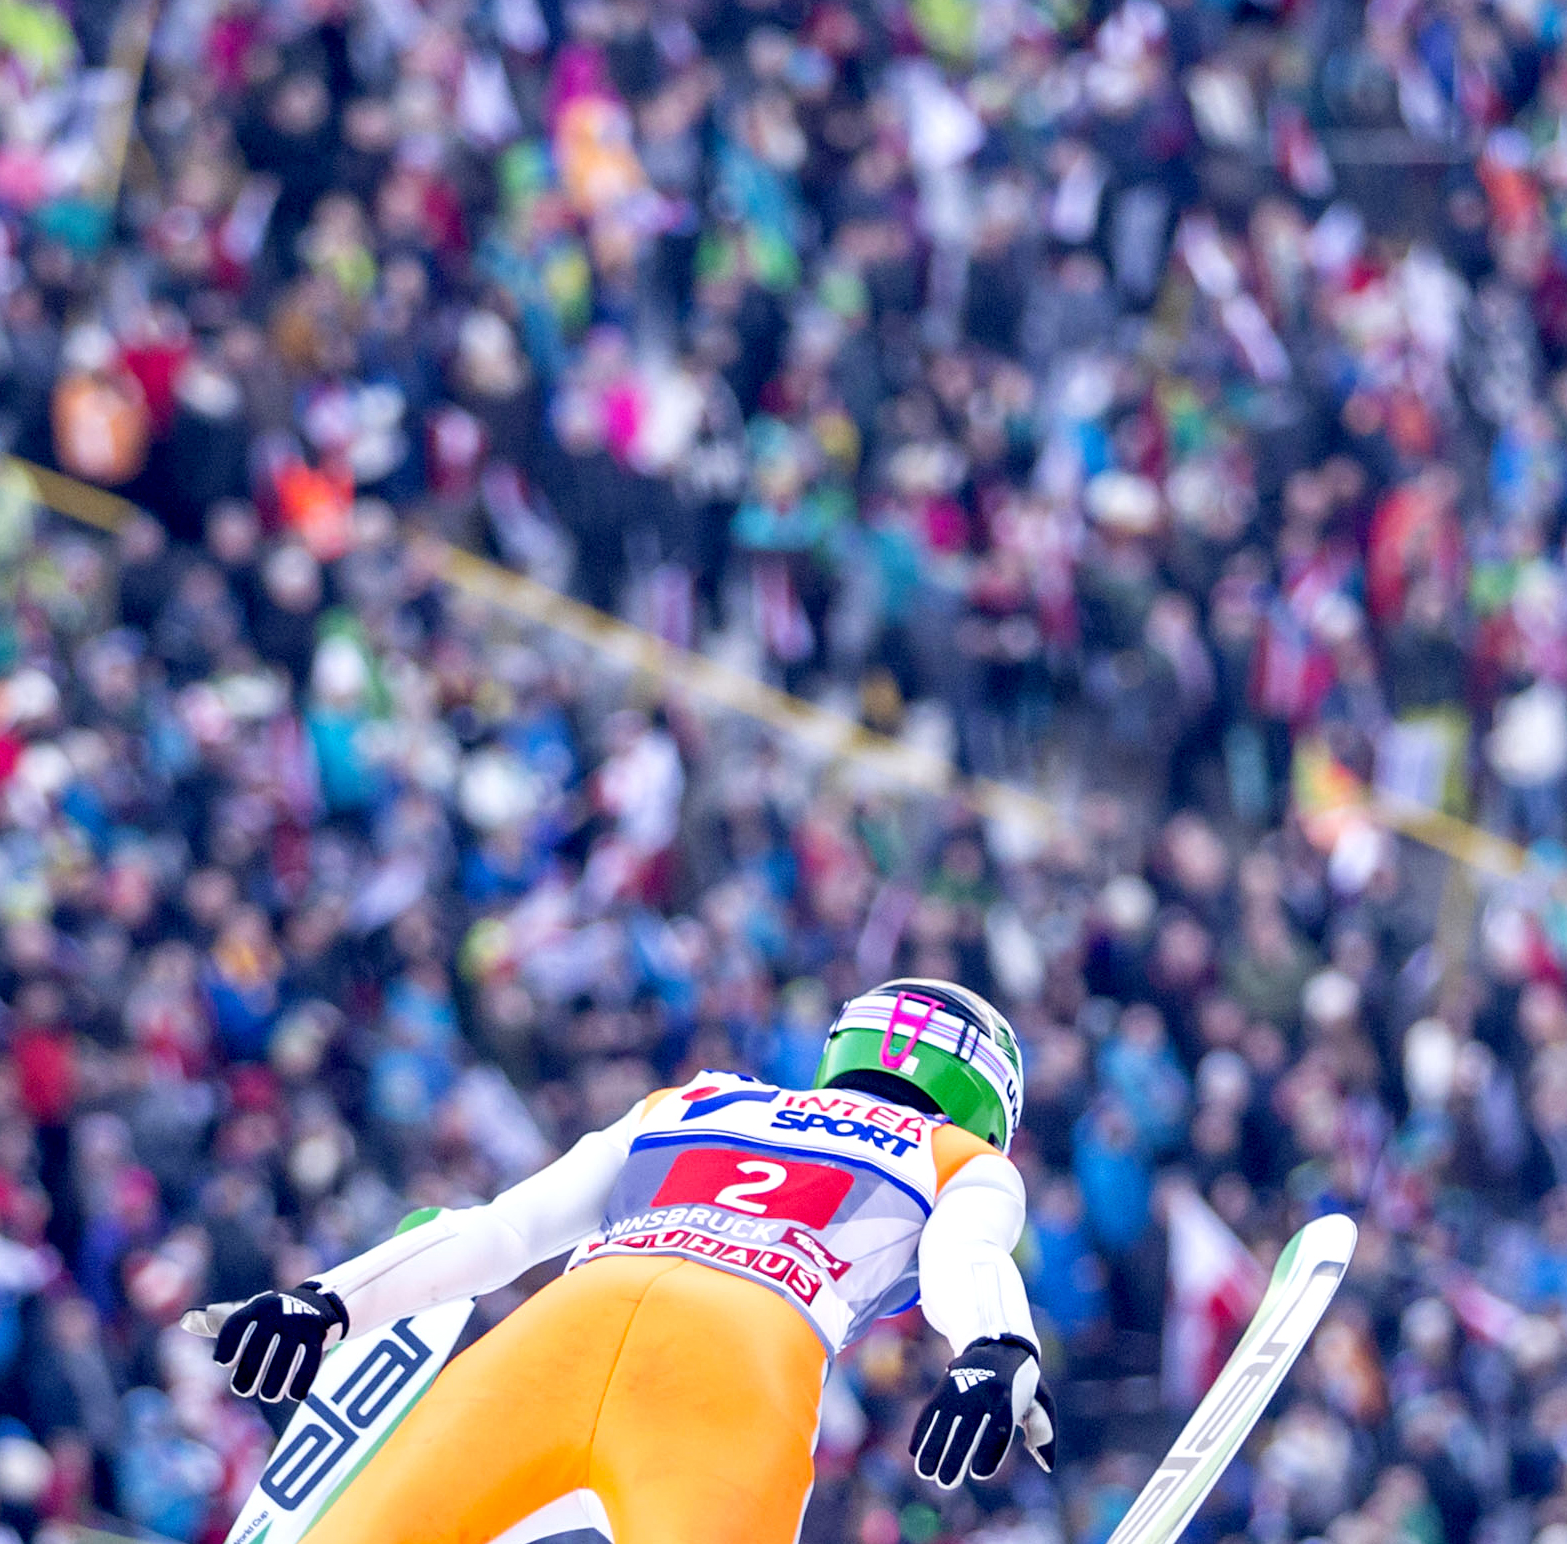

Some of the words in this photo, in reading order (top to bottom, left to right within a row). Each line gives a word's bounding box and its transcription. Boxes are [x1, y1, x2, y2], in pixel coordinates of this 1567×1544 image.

[770, 1110, 919, 1157] SPORT
[785, 1096, 927, 1142] INTER
[714, 1160, 788, 1214] 2
[606, 1207, 780, 1243] NNSBRUCK
[587, 1229, 822, 1297] UHAUS
[253, 1510, 270, 1527] Cup
